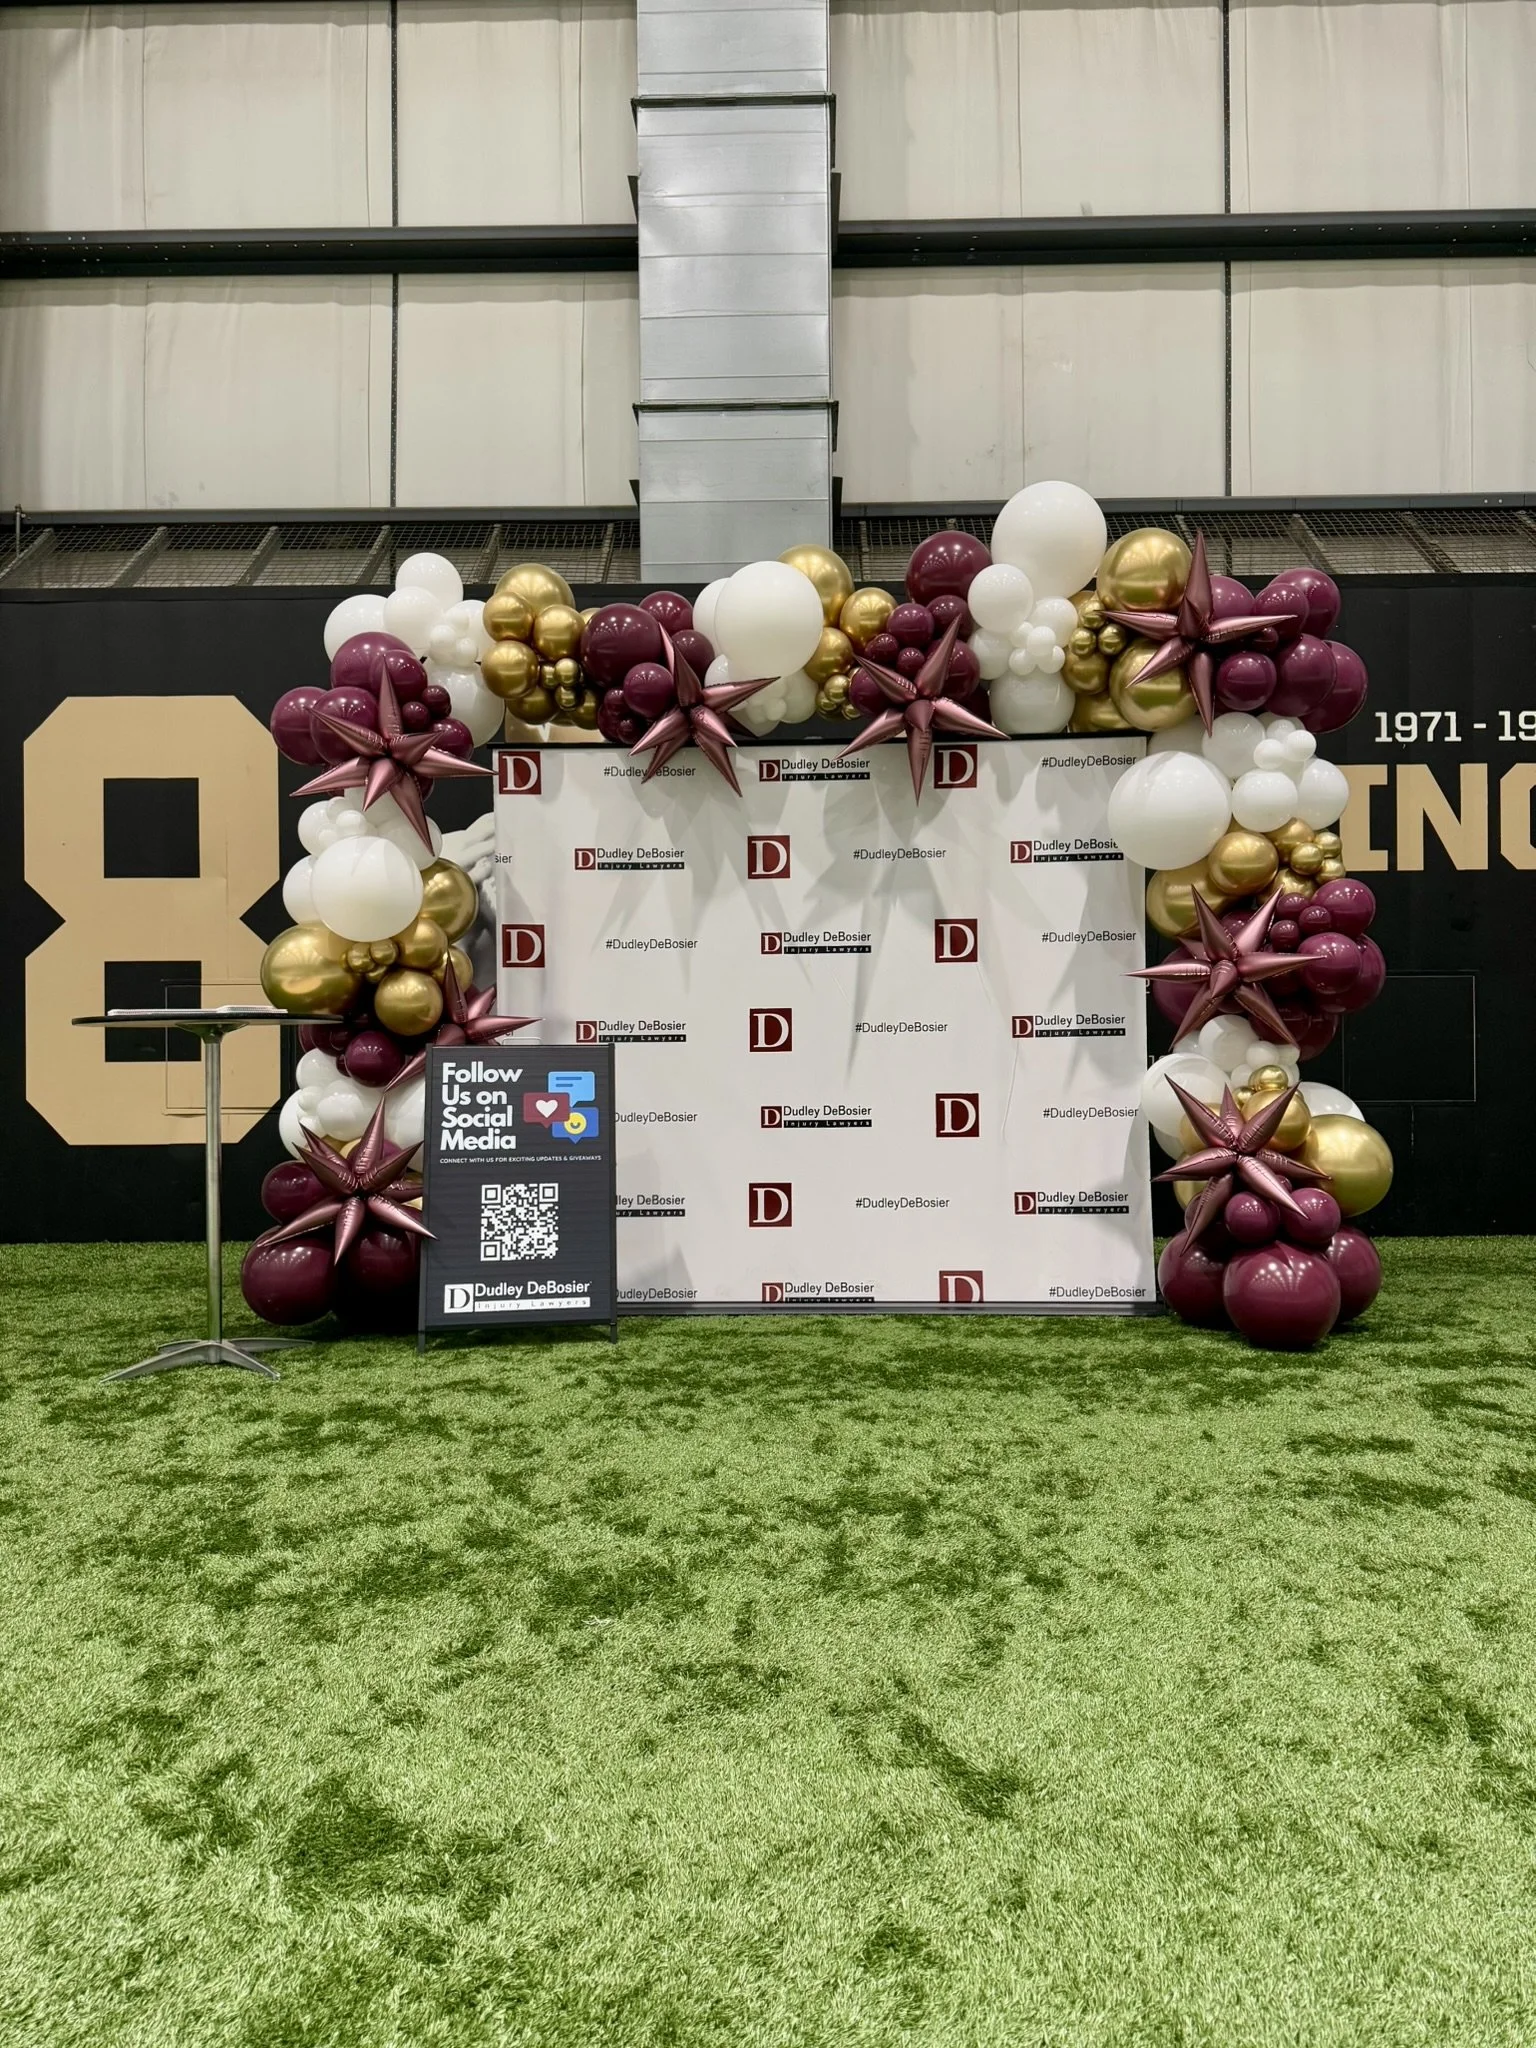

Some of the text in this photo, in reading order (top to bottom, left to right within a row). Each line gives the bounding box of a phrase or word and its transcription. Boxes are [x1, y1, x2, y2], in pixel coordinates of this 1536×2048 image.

[1374, 711, 1462, 742] 1971
[781, 759, 818, 772] Dudley
[821, 758, 870, 769] DeBosier
[938, 750, 974, 785] D
[1042, 755, 1136, 769] #DudleyDeBosier
[502, 755, 538, 791] D
[604, 766, 696, 778] #DudleyeBosier
[1033, 840, 1071, 853] Dudley
[597, 848, 633, 861] Dudley
[636, 848, 684, 858] DeBosier
[751, 840, 788, 875] D
[853, 848, 946, 861] #DudleyDeBosier
[23, 696, 280, 1144] 8
[783, 932, 820, 945] Dudley
[823, 932, 871, 942] DeBosier
[938, 923, 975, 959] D
[1042, 930, 1136, 944] #DudleyDeBosier
[506, 928, 542, 964] D
[606, 938, 698, 951] #DudleyDeBosier
[598, 1020, 635, 1033] Dudley
[638, 1020, 686, 1031] DeBosier
[1035, 1015, 1072, 1027] Dudley
[1075, 1014, 1125, 1025] DeBosier
[753, 1013, 789, 1048] D
[855, 1022, 948, 1035] #DudleyDeBosier
[442, 1061, 523, 1083] Follow
[442, 1084, 507, 1106] Us on
[441, 1105, 513, 1128] Social
[783, 1106, 820, 1118] Dudley
[823, 1105, 872, 1116] DeBosier
[939, 1098, 976, 1133] D
[1043, 1107, 1139, 1120] #DudleyDeBosier
[440, 1128, 517, 1150] Media
[636, 1194, 685, 1205] DeBosier
[752, 1187, 789, 1223] D
[856, 1197, 950, 1210] #DudleyDeBosier
[1037, 1192, 1075, 1205] Dudley
[1078, 1191, 1128, 1202] DeBosier
[448, 1280, 590, 1309] D Dudley DeBosier
[784, 1282, 822, 1295] Dudley
[825, 1282, 874, 1293] DeBosier
[1049, 1286, 1146, 1299] #DudleyDeBosier
[478, 1299, 587, 1310] Injury Lawyers
